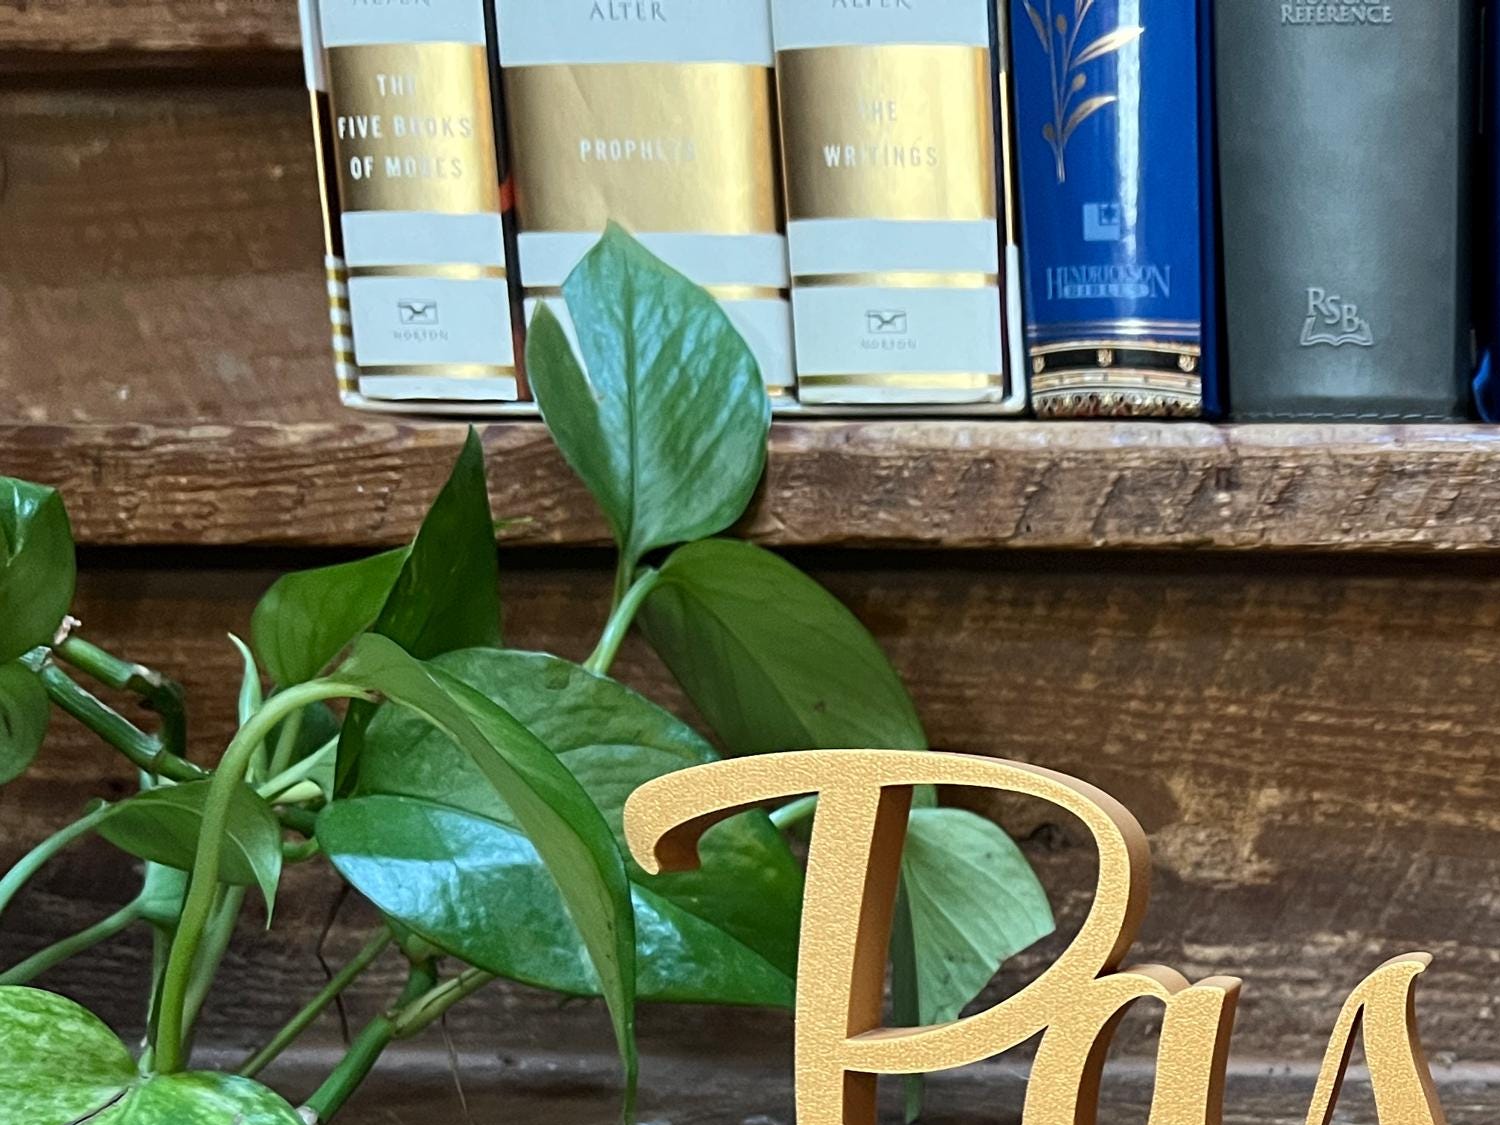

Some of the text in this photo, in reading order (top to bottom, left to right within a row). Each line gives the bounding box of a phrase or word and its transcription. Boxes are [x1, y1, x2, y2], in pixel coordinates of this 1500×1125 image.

[590, 0, 667, 22] ALTER
[1281, 4, 1393, 25] REFERENCE
[337, 115, 473, 140] FIVE BOOKS
[350, 156, 374, 181] OF
[1306, 287, 1361, 333] RSB
